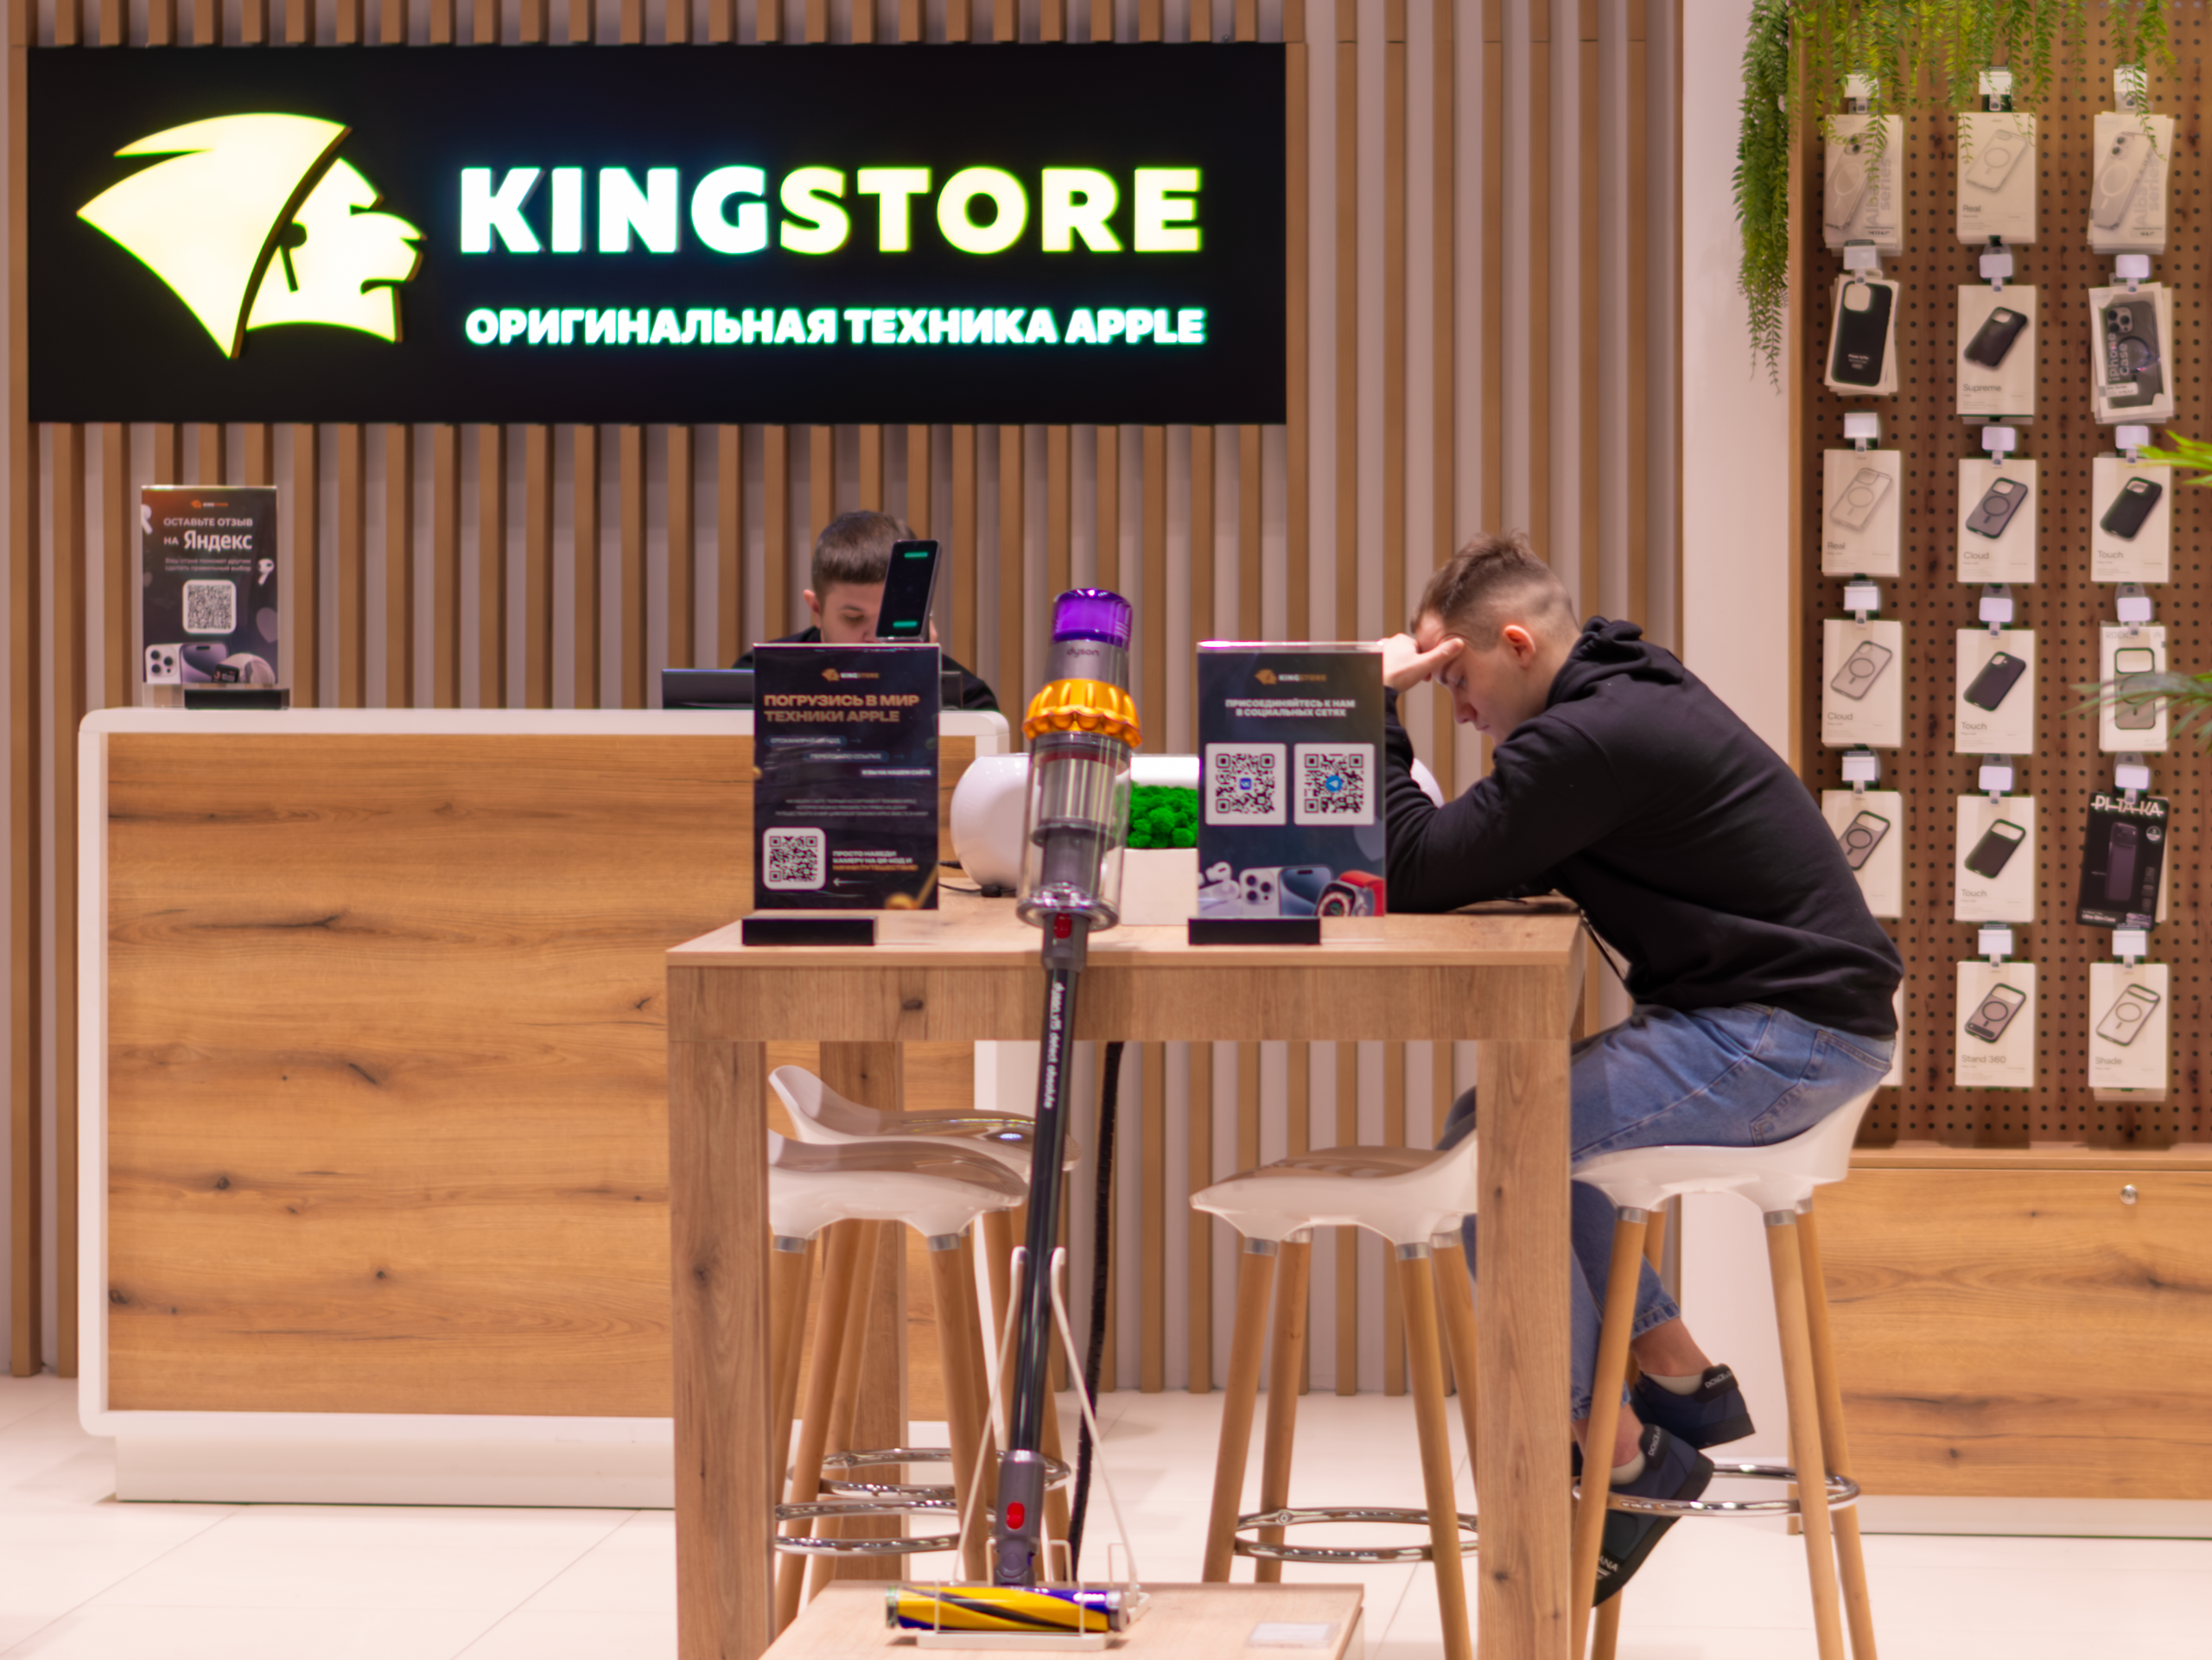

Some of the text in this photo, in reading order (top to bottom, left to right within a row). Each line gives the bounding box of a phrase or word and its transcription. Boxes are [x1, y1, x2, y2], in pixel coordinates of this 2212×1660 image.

[461, 165, 1204, 255] KINGSTORE
[1962, 203, 1981, 213] Real
[465, 308, 1207, 346] ОРИГИНАЛЬНАЯ ТЕХНИКА APPLE
[2107, 333, 2120, 382] iPhone
[1962, 383, 2002, 394] Supreme
[163, 518, 254, 527] ОСТАВЬТЕ ОТЗЫВ
[163, 530, 253, 552] НА Яндекс
[1827, 541, 1847, 550] Real
[1963, 550, 1990, 560] Cloud
[2097, 550, 2124, 559] Touch
[1065, 647, 1100, 658] dyson
[763, 695, 920, 707] ПОГРУЗИСЬ В МИР
[1225, 698, 1356, 709] ПРИСОЕДИНЯЙТЕСЬ К НАМ
[764, 710, 900, 722] ТЕХНИКИ APPLE
[1236, 708, 1347, 718] В СОЦИАЛЬНЫХ СЕТЯХ
[1827, 711, 1853, 722] Cloud
[1961, 722, 1987, 731] Touch
[1961, 888, 1987, 898] Touch
[1961, 1054, 2006, 1064] Stand 360
[2094, 1056, 2122, 1065] Shade
